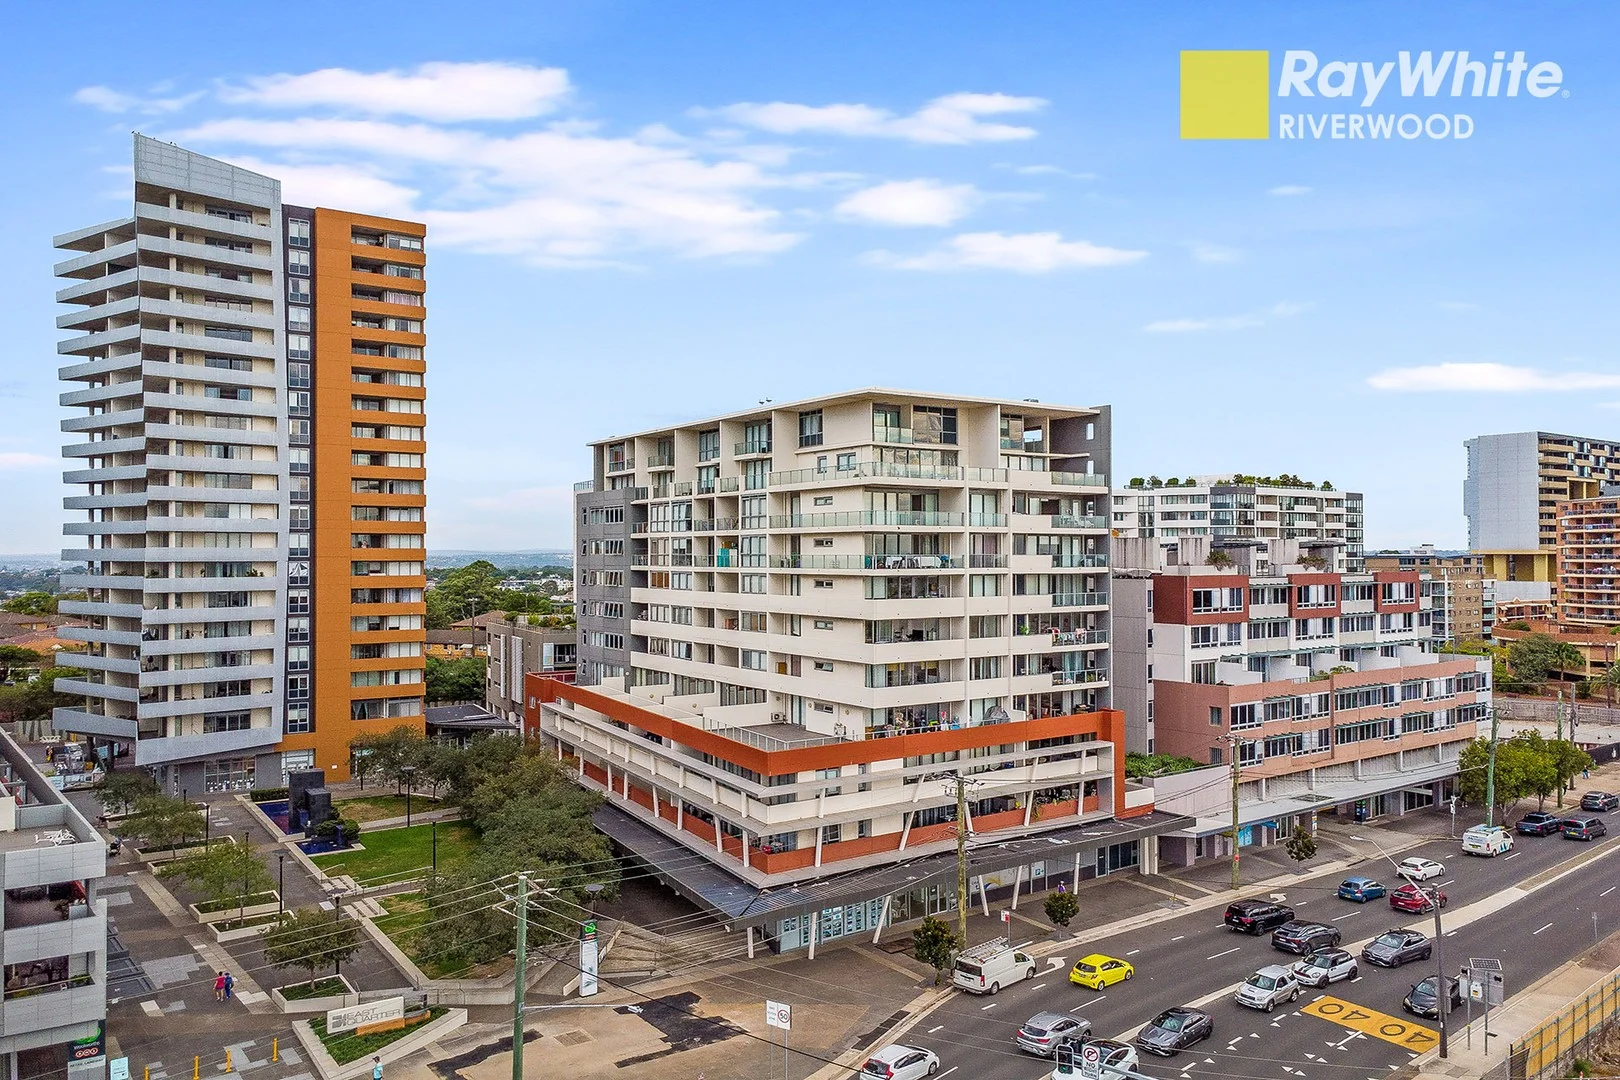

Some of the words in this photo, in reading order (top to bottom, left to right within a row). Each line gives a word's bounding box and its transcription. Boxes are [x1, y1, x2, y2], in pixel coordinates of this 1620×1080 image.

[347, 1007, 377, 1018] EAST
[347, 1009, 400, 1024] QUARTER
[780, 1012, 788, 1020] 50
